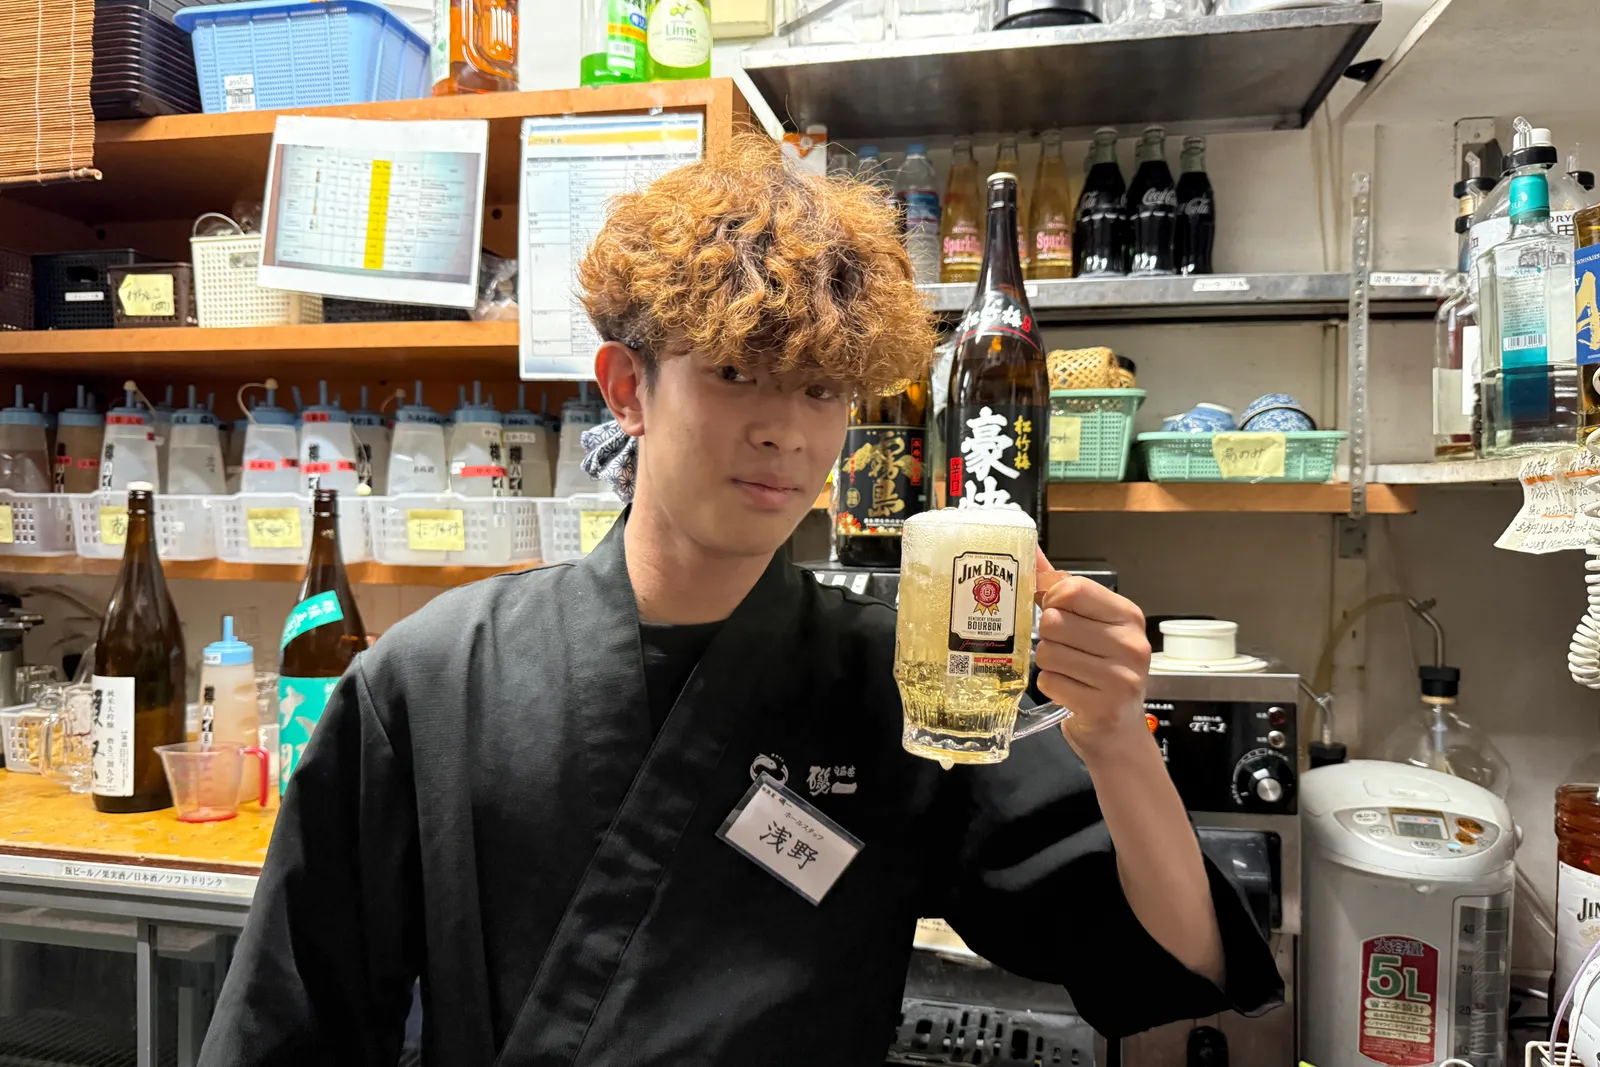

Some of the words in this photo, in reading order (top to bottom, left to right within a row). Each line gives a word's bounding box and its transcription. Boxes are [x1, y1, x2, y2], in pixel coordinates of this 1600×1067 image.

[665, 24, 697, 38] Lime
[1013, 415, 1032, 470] 松竹梅
[958, 564, 982, 585] JIM
[984, 559, 1014, 588] BEAM
[967, 620, 1002, 632] BOURBON
[1189, 721, 1227, 733] Ti-1
[806, 765, 858, 797] 磯一
[784, 811, 825, 841] ホールスタッフ
[759, 819, 819, 870] 浅野
[1374, 938, 1425, 957] 大容量
[1366, 953, 1432, 1003] 5L
[1459, 1006, 1471, 1016] 2.0
